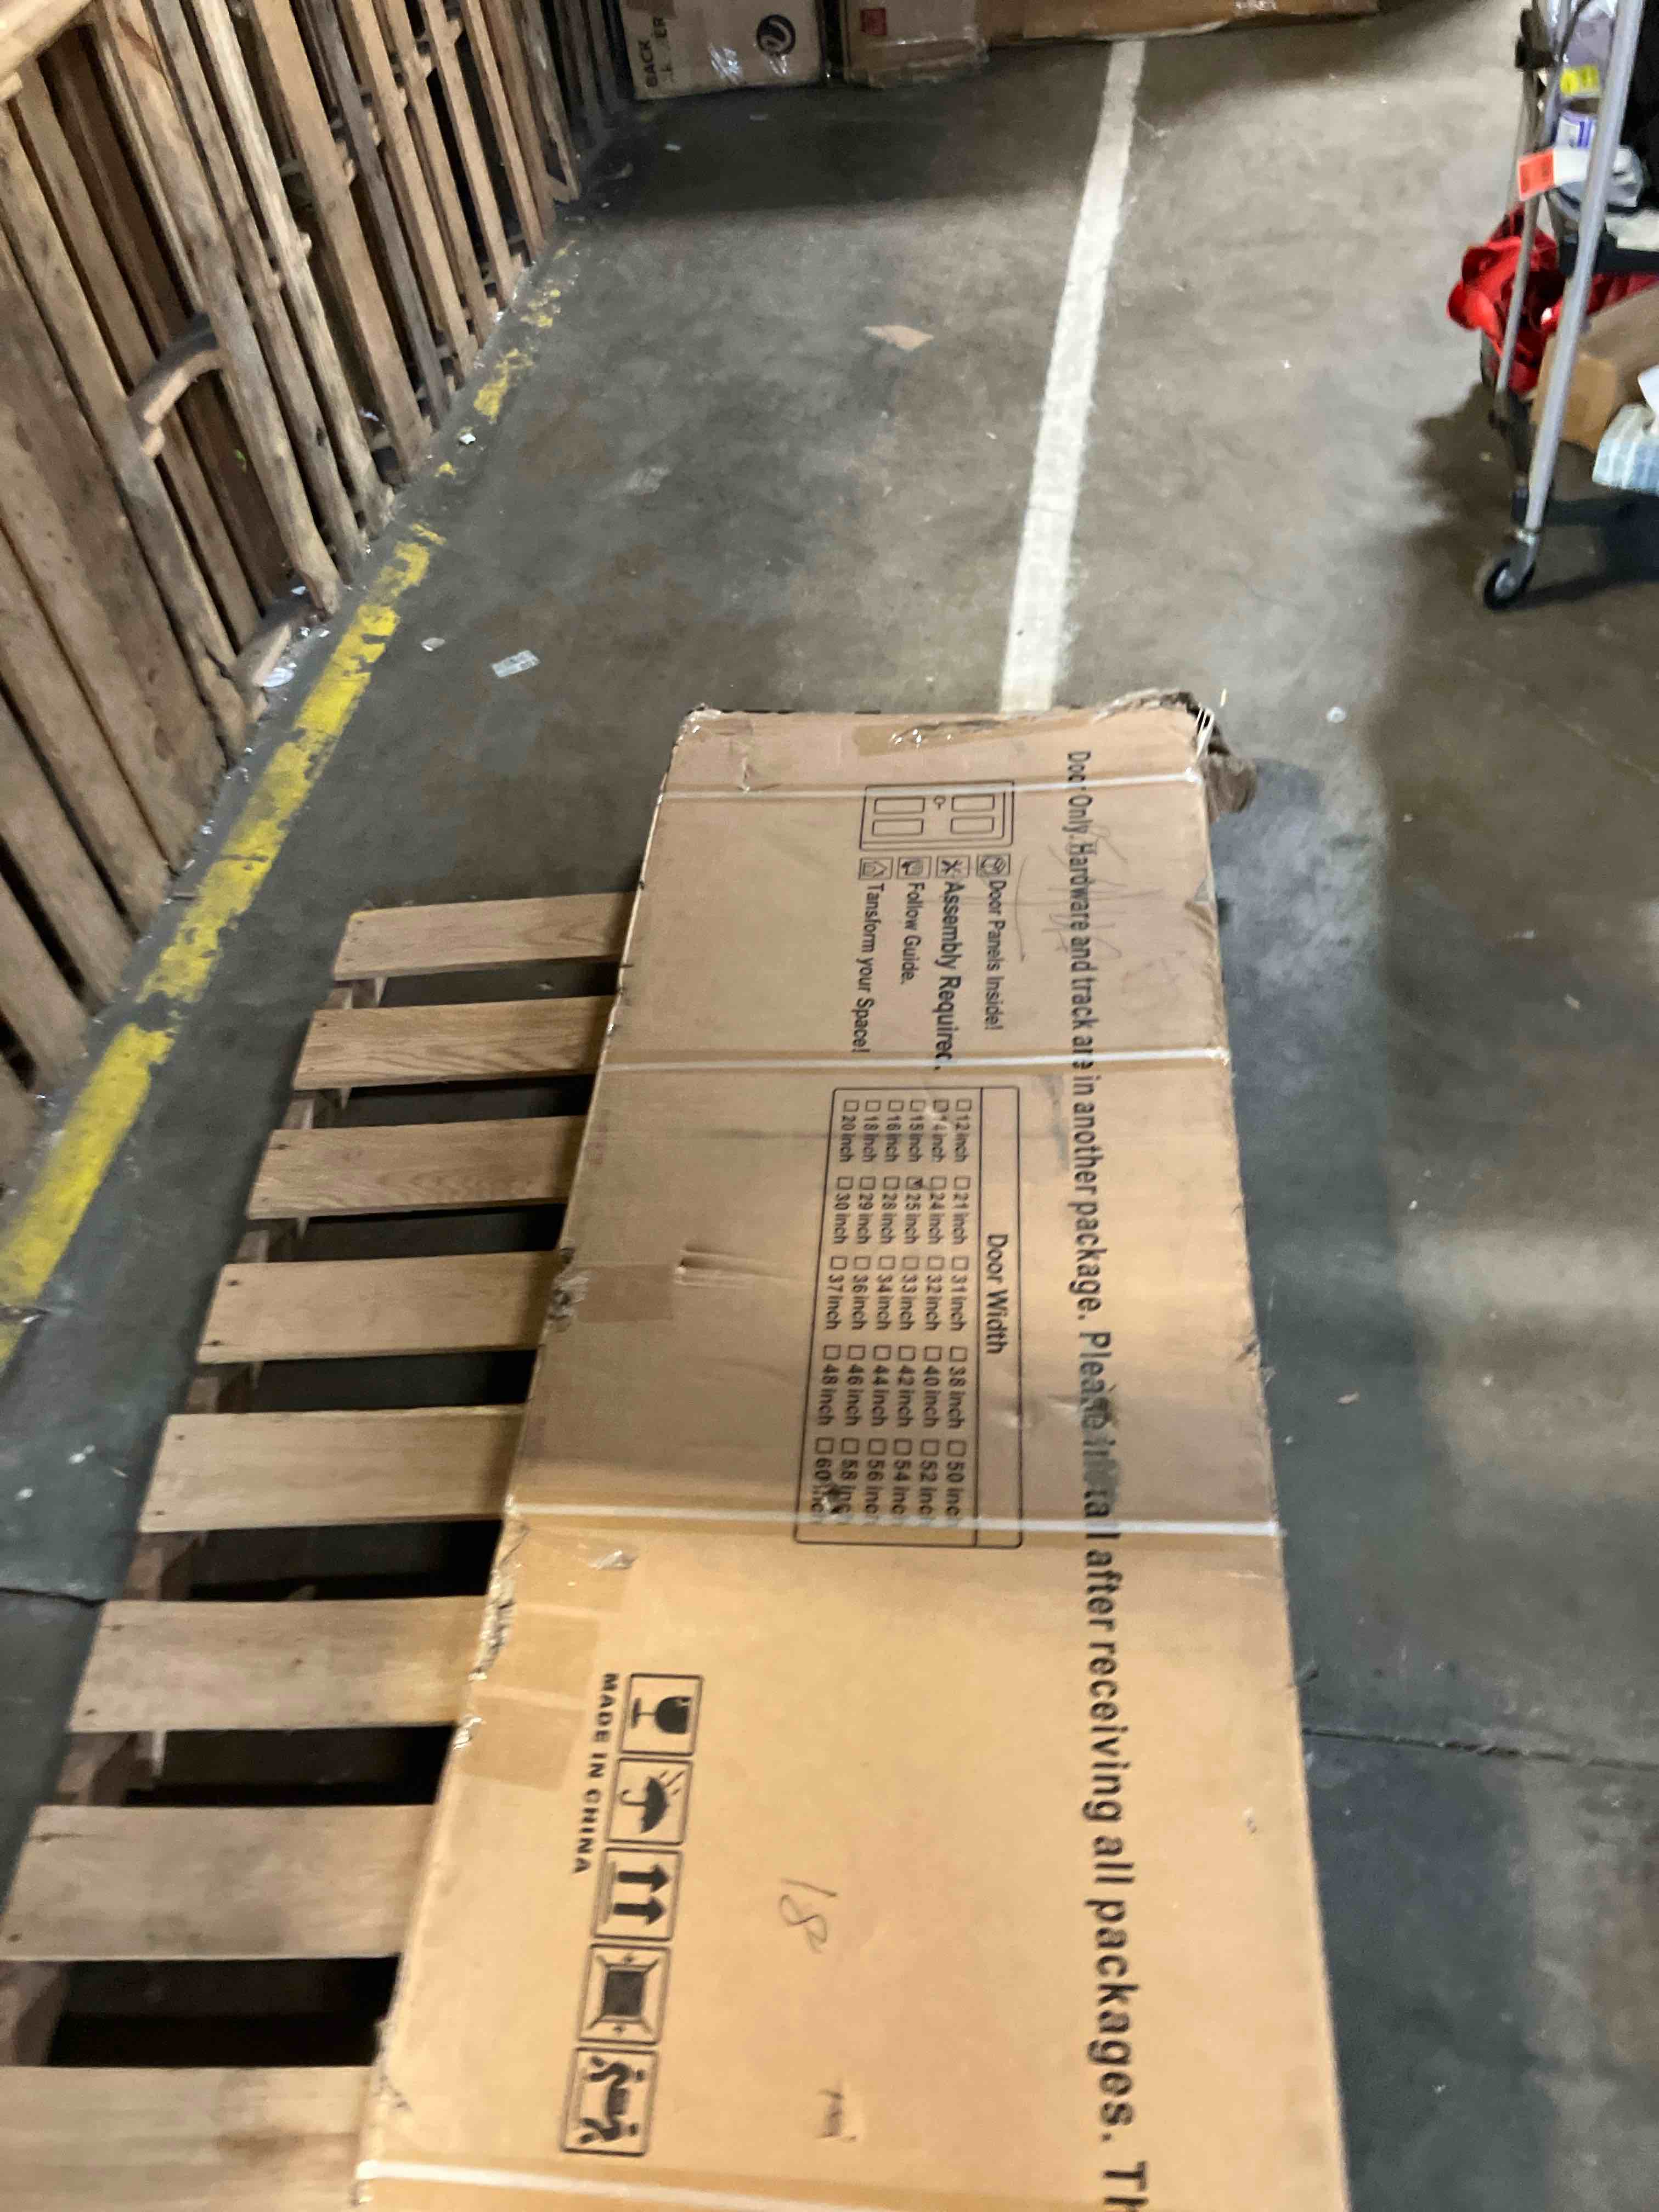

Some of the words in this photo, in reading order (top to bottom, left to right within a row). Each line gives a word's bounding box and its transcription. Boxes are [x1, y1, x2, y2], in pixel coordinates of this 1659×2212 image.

[1066, 751, 1091, 791] Doo
[988, 880, 1007, 915] Door
[1069, 843, 1097, 931] Hardware
[862, 883, 884, 952] Tansform
[904, 882, 925, 929] Follow
[935, 882, 964, 969] Assembly
[900, 935, 921, 985] Guide.
[986, 921, 1005, 971] Panels
[1070, 937, 1097, 972] and
[857, 958, 875, 992] your
[984, 977, 1005, 1030] Inside!
[1071, 975, 1099, 1030] track
[851, 998, 874, 1053] Space!
[1071, 1035, 1096, 1069] are
[1073, 1075, 1102, 1096] in
[842, 1115, 856, 1130] 20
[909, 1115, 923, 1130] 15
[956, 1114, 970, 1130] 12
[839, 1133, 855, 1163] inch
[862, 1133, 878, 1163] inch
[885, 1133, 901, 1163] inch
[908, 1133, 923, 1163] inch
[931, 1133, 946, 1163] inch
[953, 1133, 969, 1163] inch
[1073, 1102, 1103, 1195] another
[834, 1192, 850, 1210] 30
[859, 1192, 874, 1210] 29
[906, 1192, 921, 1210] 25
[929, 1192, 945, 1209] 24
[953, 1192, 968, 1209] 21
[833, 1213, 849, 1244] inch
[856, 1213, 872, 1244] inch
[881, 1212, 898, 1244] inch
[904, 1213, 921, 1244] inch
[928, 1212, 944, 1244] inch
[952, 1213, 969, 1244] inch
[986, 1234, 1008, 1283] Door
[1068, 1201, 1107, 1320] package.
[827, 1274, 844, 1293] 37
[853, 1274, 868, 1293] 36
[877, 1274, 893, 1293] 34
[901, 1274, 917, 1293] 33
[926, 1274, 942, 1293] 32
[951, 1274, 968, 1293] 31
[826, 1296, 844, 1330] inch
[851, 1296, 869, 1330] inch
[876, 1296, 894, 1330] inch
[899, 1296, 917, 1330] inch
[925, 1296, 942, 1330] inch
[950, 1296, 967, 1331] inch
[986, 1289, 1008, 1354] Width
[822, 1364, 839, 1384] 48
[848, 1364, 865, 1385] 46
[873, 1364, 890, 1385] 44
[899, 1365, 916, 1386] 42
[924, 1365, 941, 1386] 40
[949, 1366, 966, 1386] 38
[817, 1389, 837, 1426] inch
[845, 1389, 864, 1426] inch
[871, 1390, 889, 1427] inch
[896, 1390, 915, 1427] inch
[922, 1390, 940, 1427] inch
[947, 1391, 966, 1429] inch
[816, 1458, 832, 1480] 60
[841, 1459, 857, 1480] 58
[868, 1459, 884, 1481] 56
[894, 1459, 911, 1482] 54
[920, 1460, 937, 1482] 52
[947, 1461, 964, 1483] 50
[865, 1486, 883, 1514] inc
[891, 1486, 910, 1515] inc
[919, 1487, 937, 1515] inc
[946, 1488, 964, 1516] inc
[1087, 1550, 1124, 1632] after
[594, 1673, 619, 1742] MADE
[1083, 1641, 1132, 1822] receiving
[588, 1753, 608, 1779] IN
[574, 1789, 603, 1873] CHINA
[1093, 1836, 1135, 1884] all
[1085, 1899, 1141, 2142] packages.
